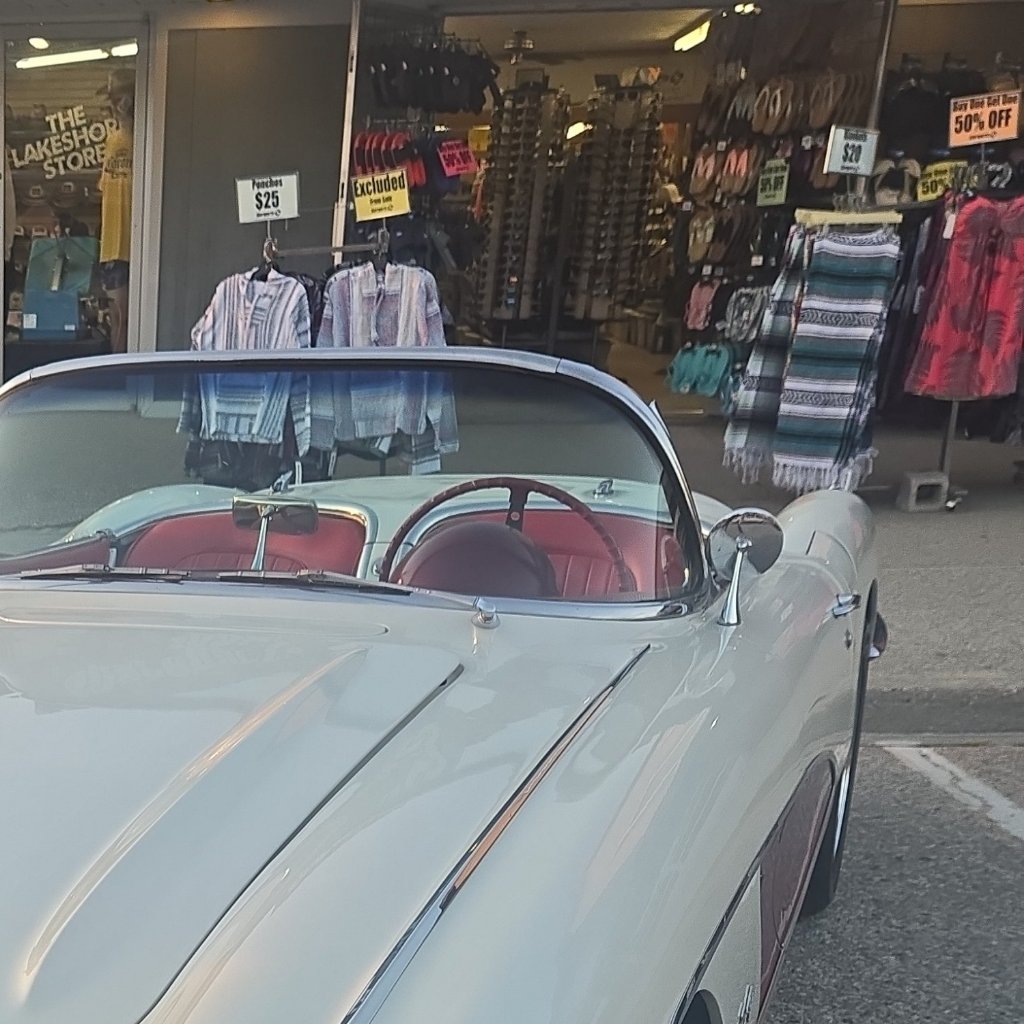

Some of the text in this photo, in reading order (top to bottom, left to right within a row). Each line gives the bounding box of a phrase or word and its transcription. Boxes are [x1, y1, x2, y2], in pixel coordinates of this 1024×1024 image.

[45, 104, 87, 134] THE
[954, 108, 1012, 134] 50% OFF
[11, 118, 120, 168] LAKESHOR
[43, 143, 106, 180] STORE
[354, 170, 406, 198] Excluded
[255, 190, 279, 211] $25
